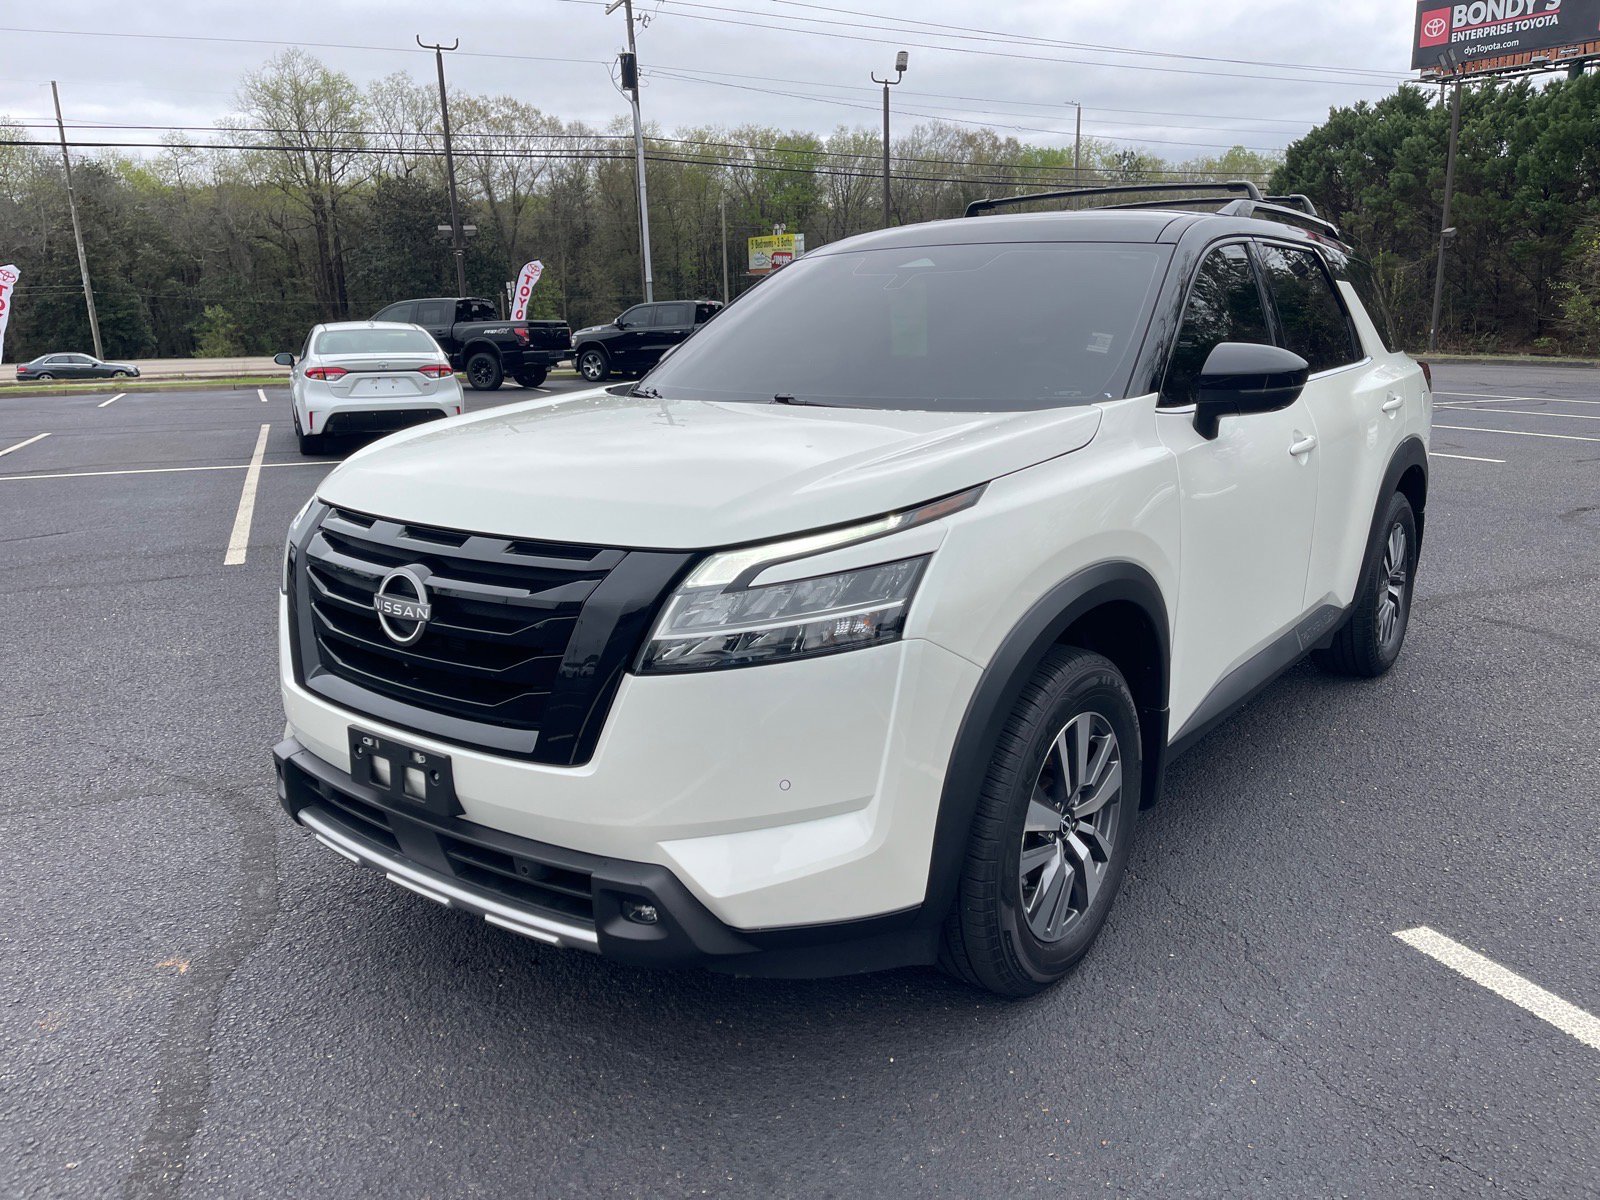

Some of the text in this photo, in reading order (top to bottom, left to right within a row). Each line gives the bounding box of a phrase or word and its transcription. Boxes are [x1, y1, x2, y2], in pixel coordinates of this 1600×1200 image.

[1452, 0, 1561, 28] BONDY
[1451, 14, 1559, 43] ENTERPRISE TOYOTA
[373, 597, 429, 620] NISSAN
